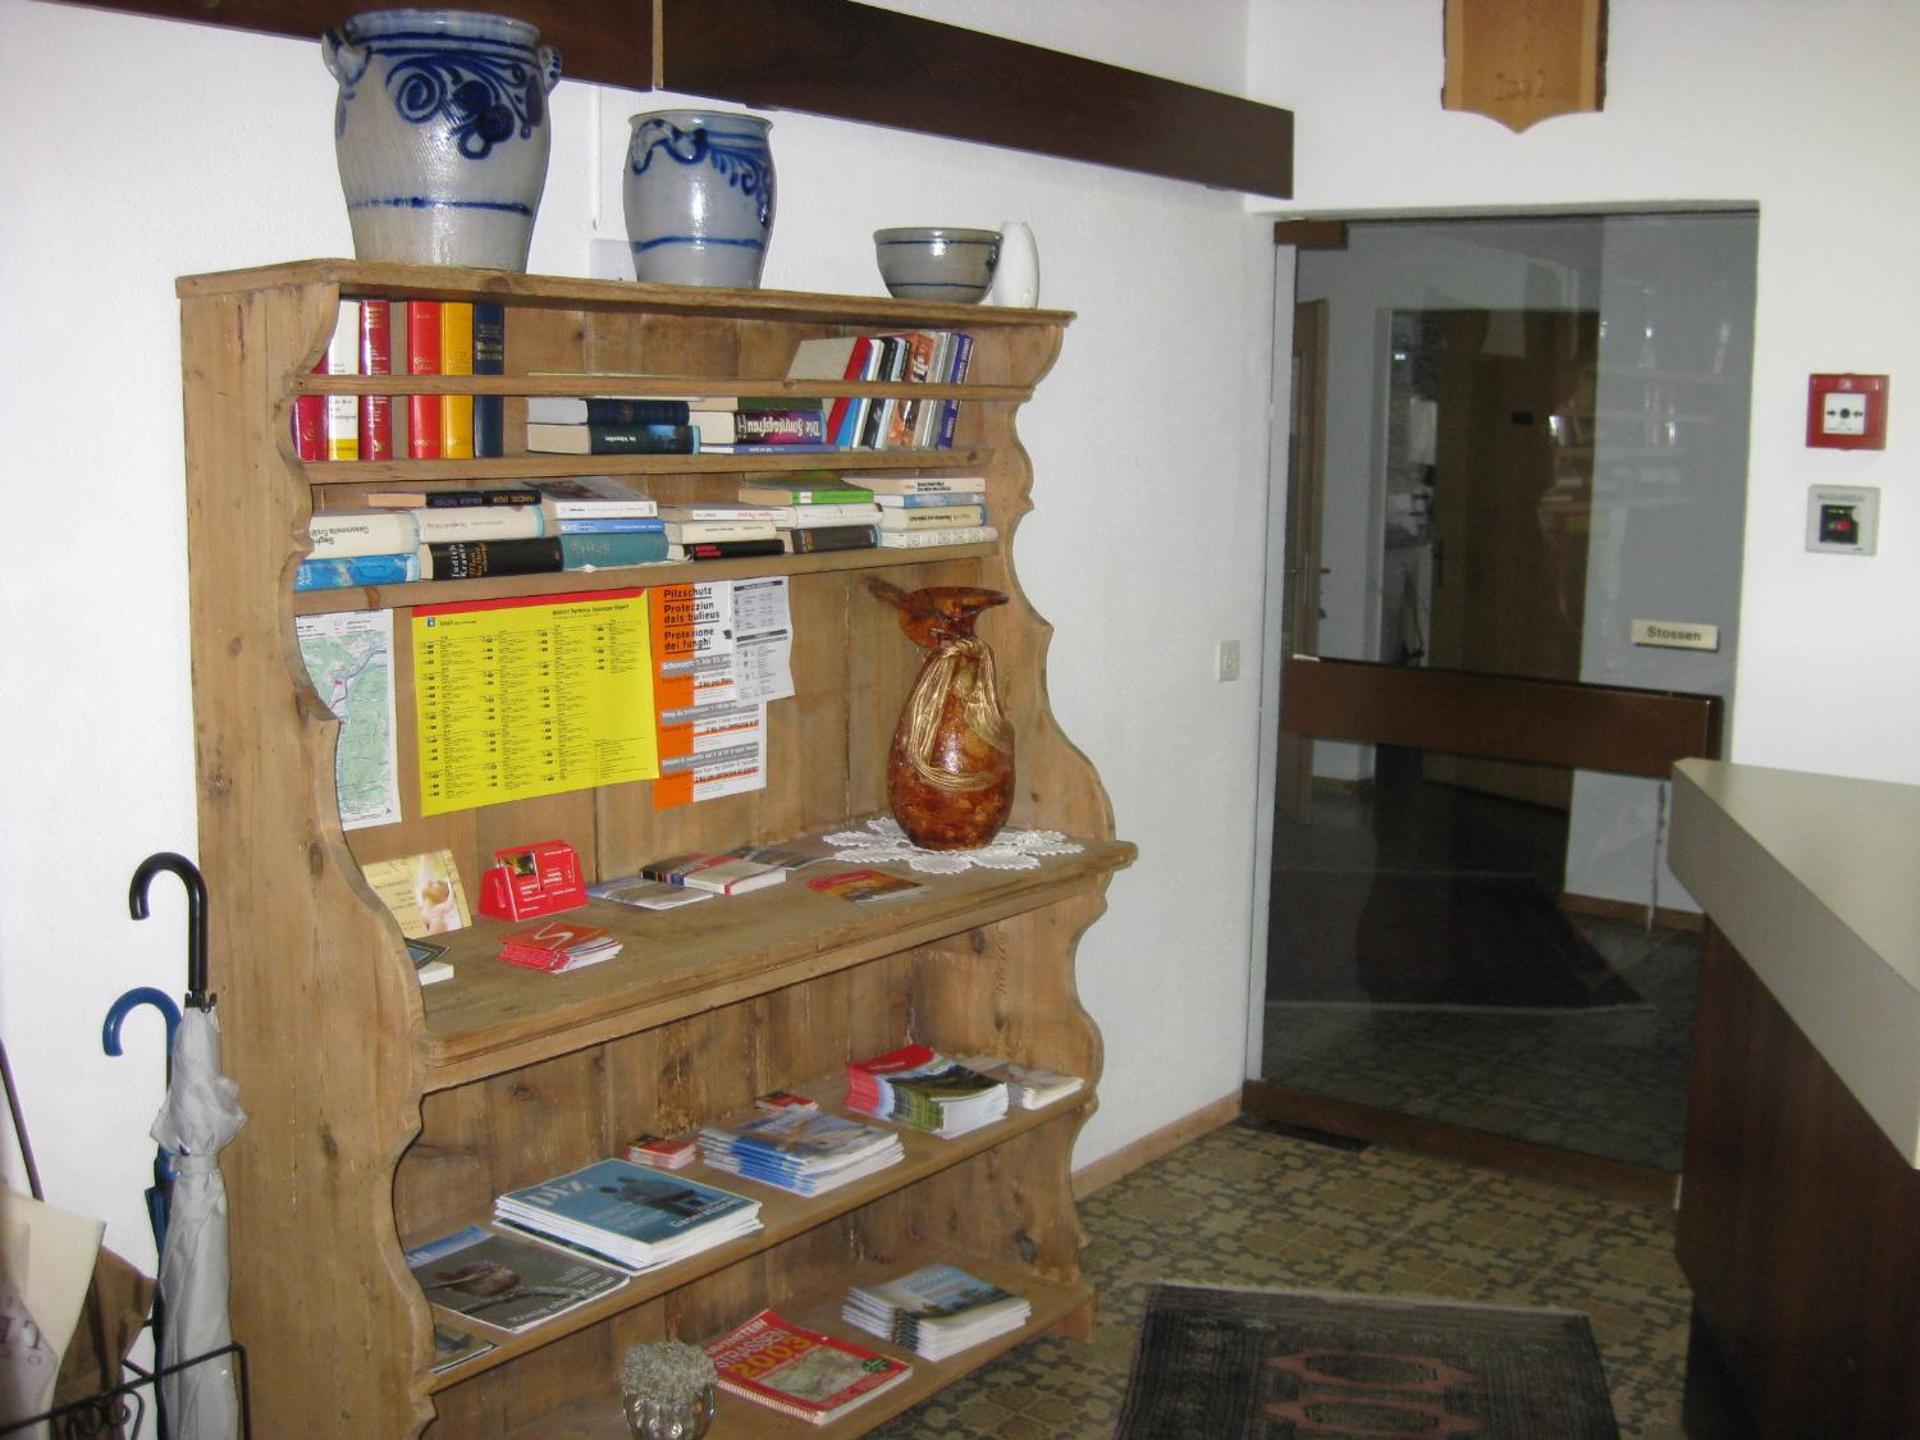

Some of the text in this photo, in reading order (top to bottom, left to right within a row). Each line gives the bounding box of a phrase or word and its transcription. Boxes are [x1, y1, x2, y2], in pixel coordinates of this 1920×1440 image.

[805, 421, 820, 437] Die
[663, 586, 712, 599] Pilzschutz
[1647, 626, 1701, 641] Stossen
[664, 637, 711, 651] dei funghi
[728, 1335, 812, 1378] 2003
